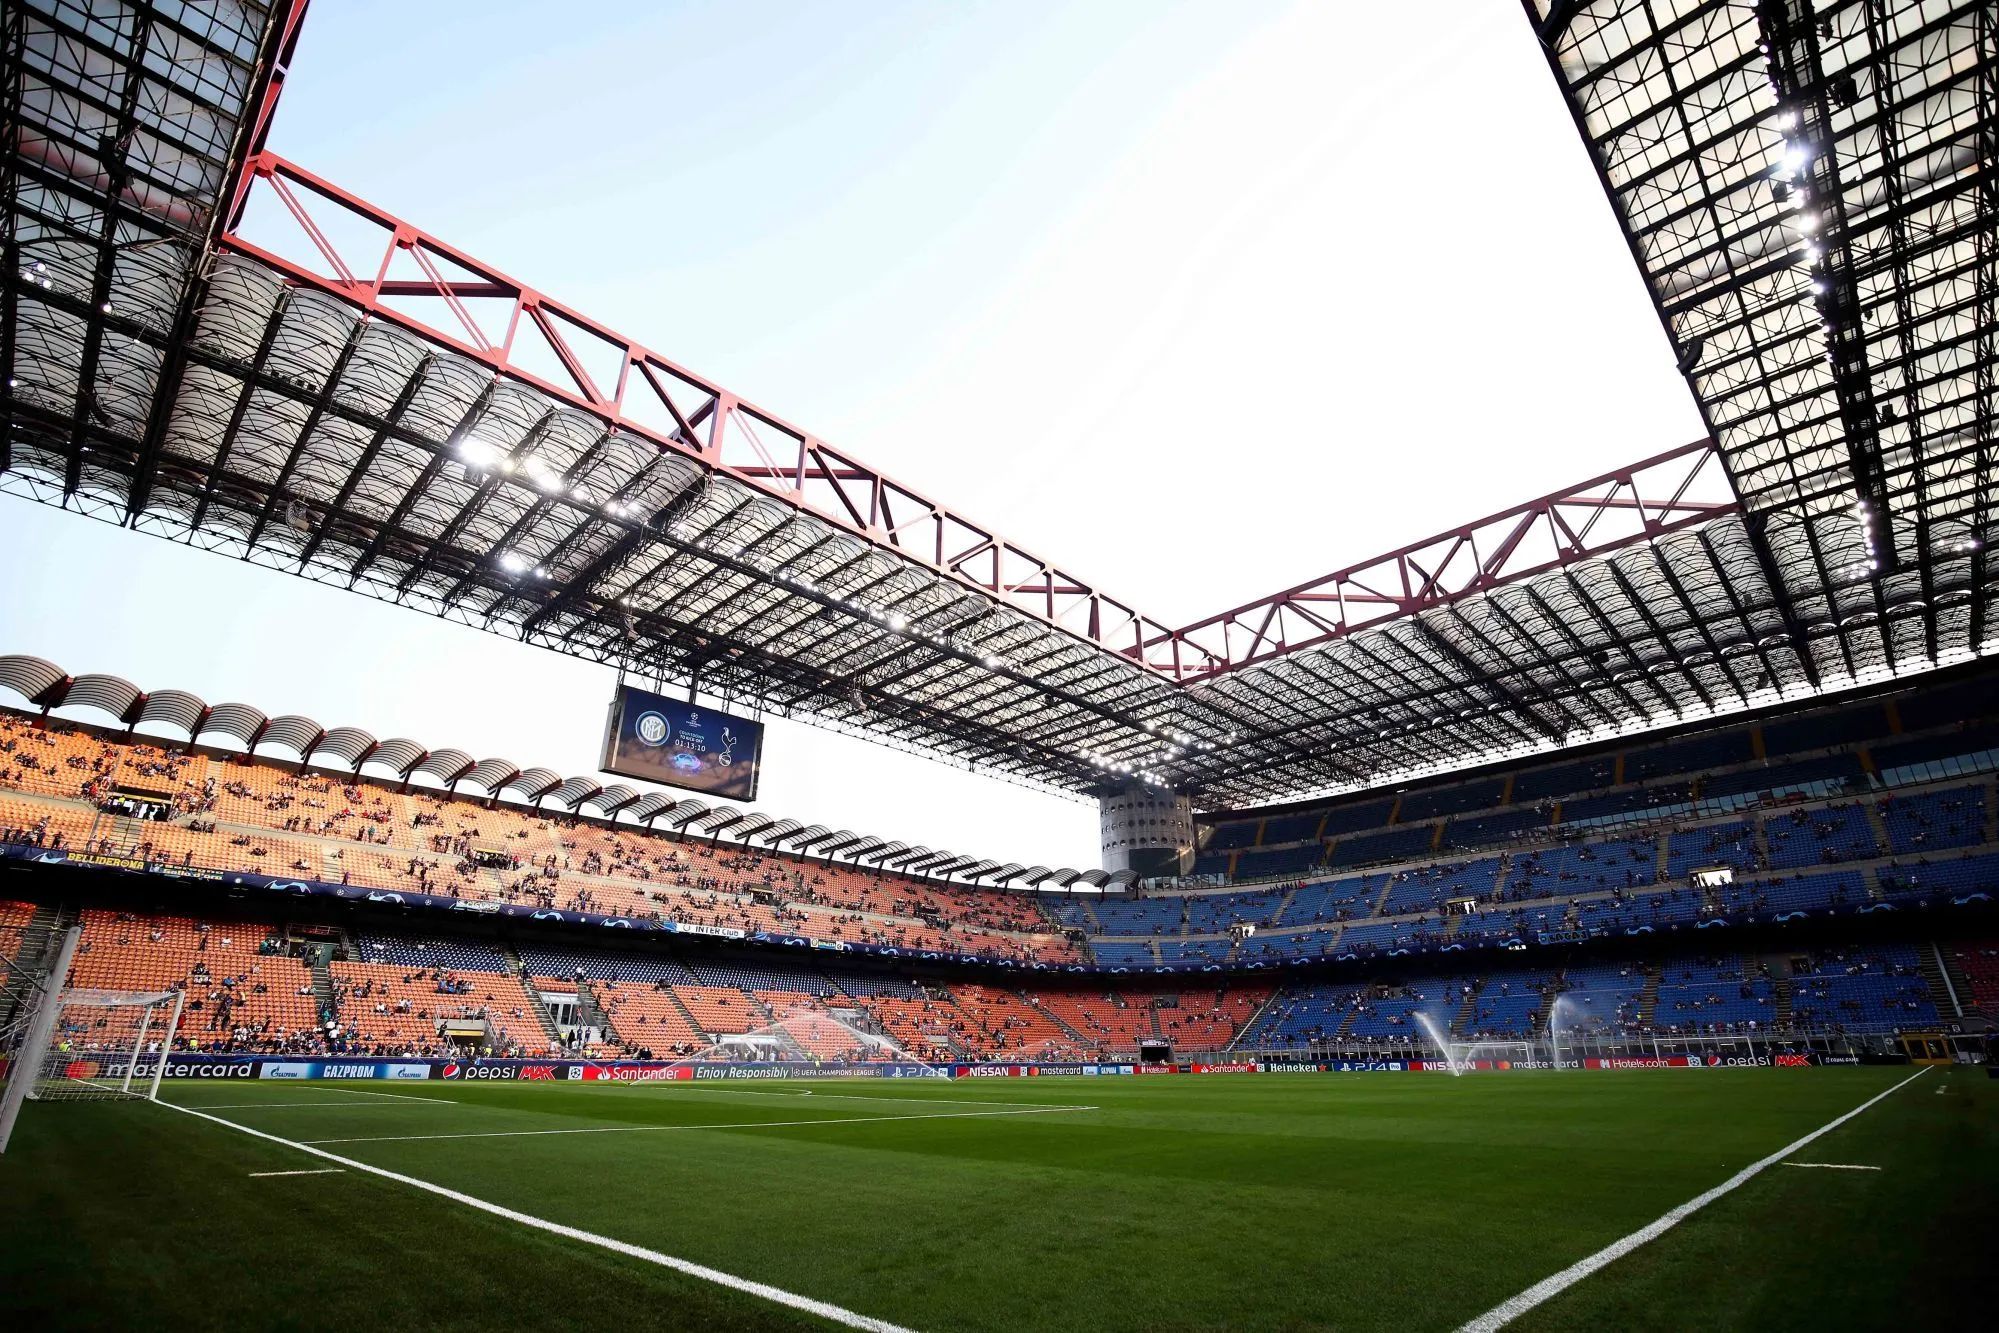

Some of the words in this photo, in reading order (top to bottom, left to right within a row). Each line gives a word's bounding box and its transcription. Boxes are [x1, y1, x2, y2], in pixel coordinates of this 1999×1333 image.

[675, 739, 706, 752] 01:13:10
[695, 926, 720, 935] INTER
[722, 928, 739, 936] Club
[1422, 1061, 1476, 1071] NISSAN
[1513, 1059, 1579, 1069] mastercard
[1727, 1056, 1771, 1067] pepsi
[1774, 1055, 1812, 1067] MAX
[107, 1062, 252, 1077] mastercard
[323, 1065, 375, 1078] GAZPROM
[969, 1067, 1009, 1076] NISSAN
[1040, 1066, 1081, 1075] mastercard
[1146, 1066, 1169, 1074] Hotels.com
[1209, 1063, 1249, 1073] Santander
[1270, 1063, 1317, 1073] Heineken
[1355, 1062, 1387, 1071] PS4
[465, 1065, 516, 1080] pepsi
[518, 1065, 558, 1081] MAX
[613, 1066, 680, 1080] Santander
[696, 1066, 727, 1080] Enjoy
[729, 1066, 789, 1079] Responsibly
